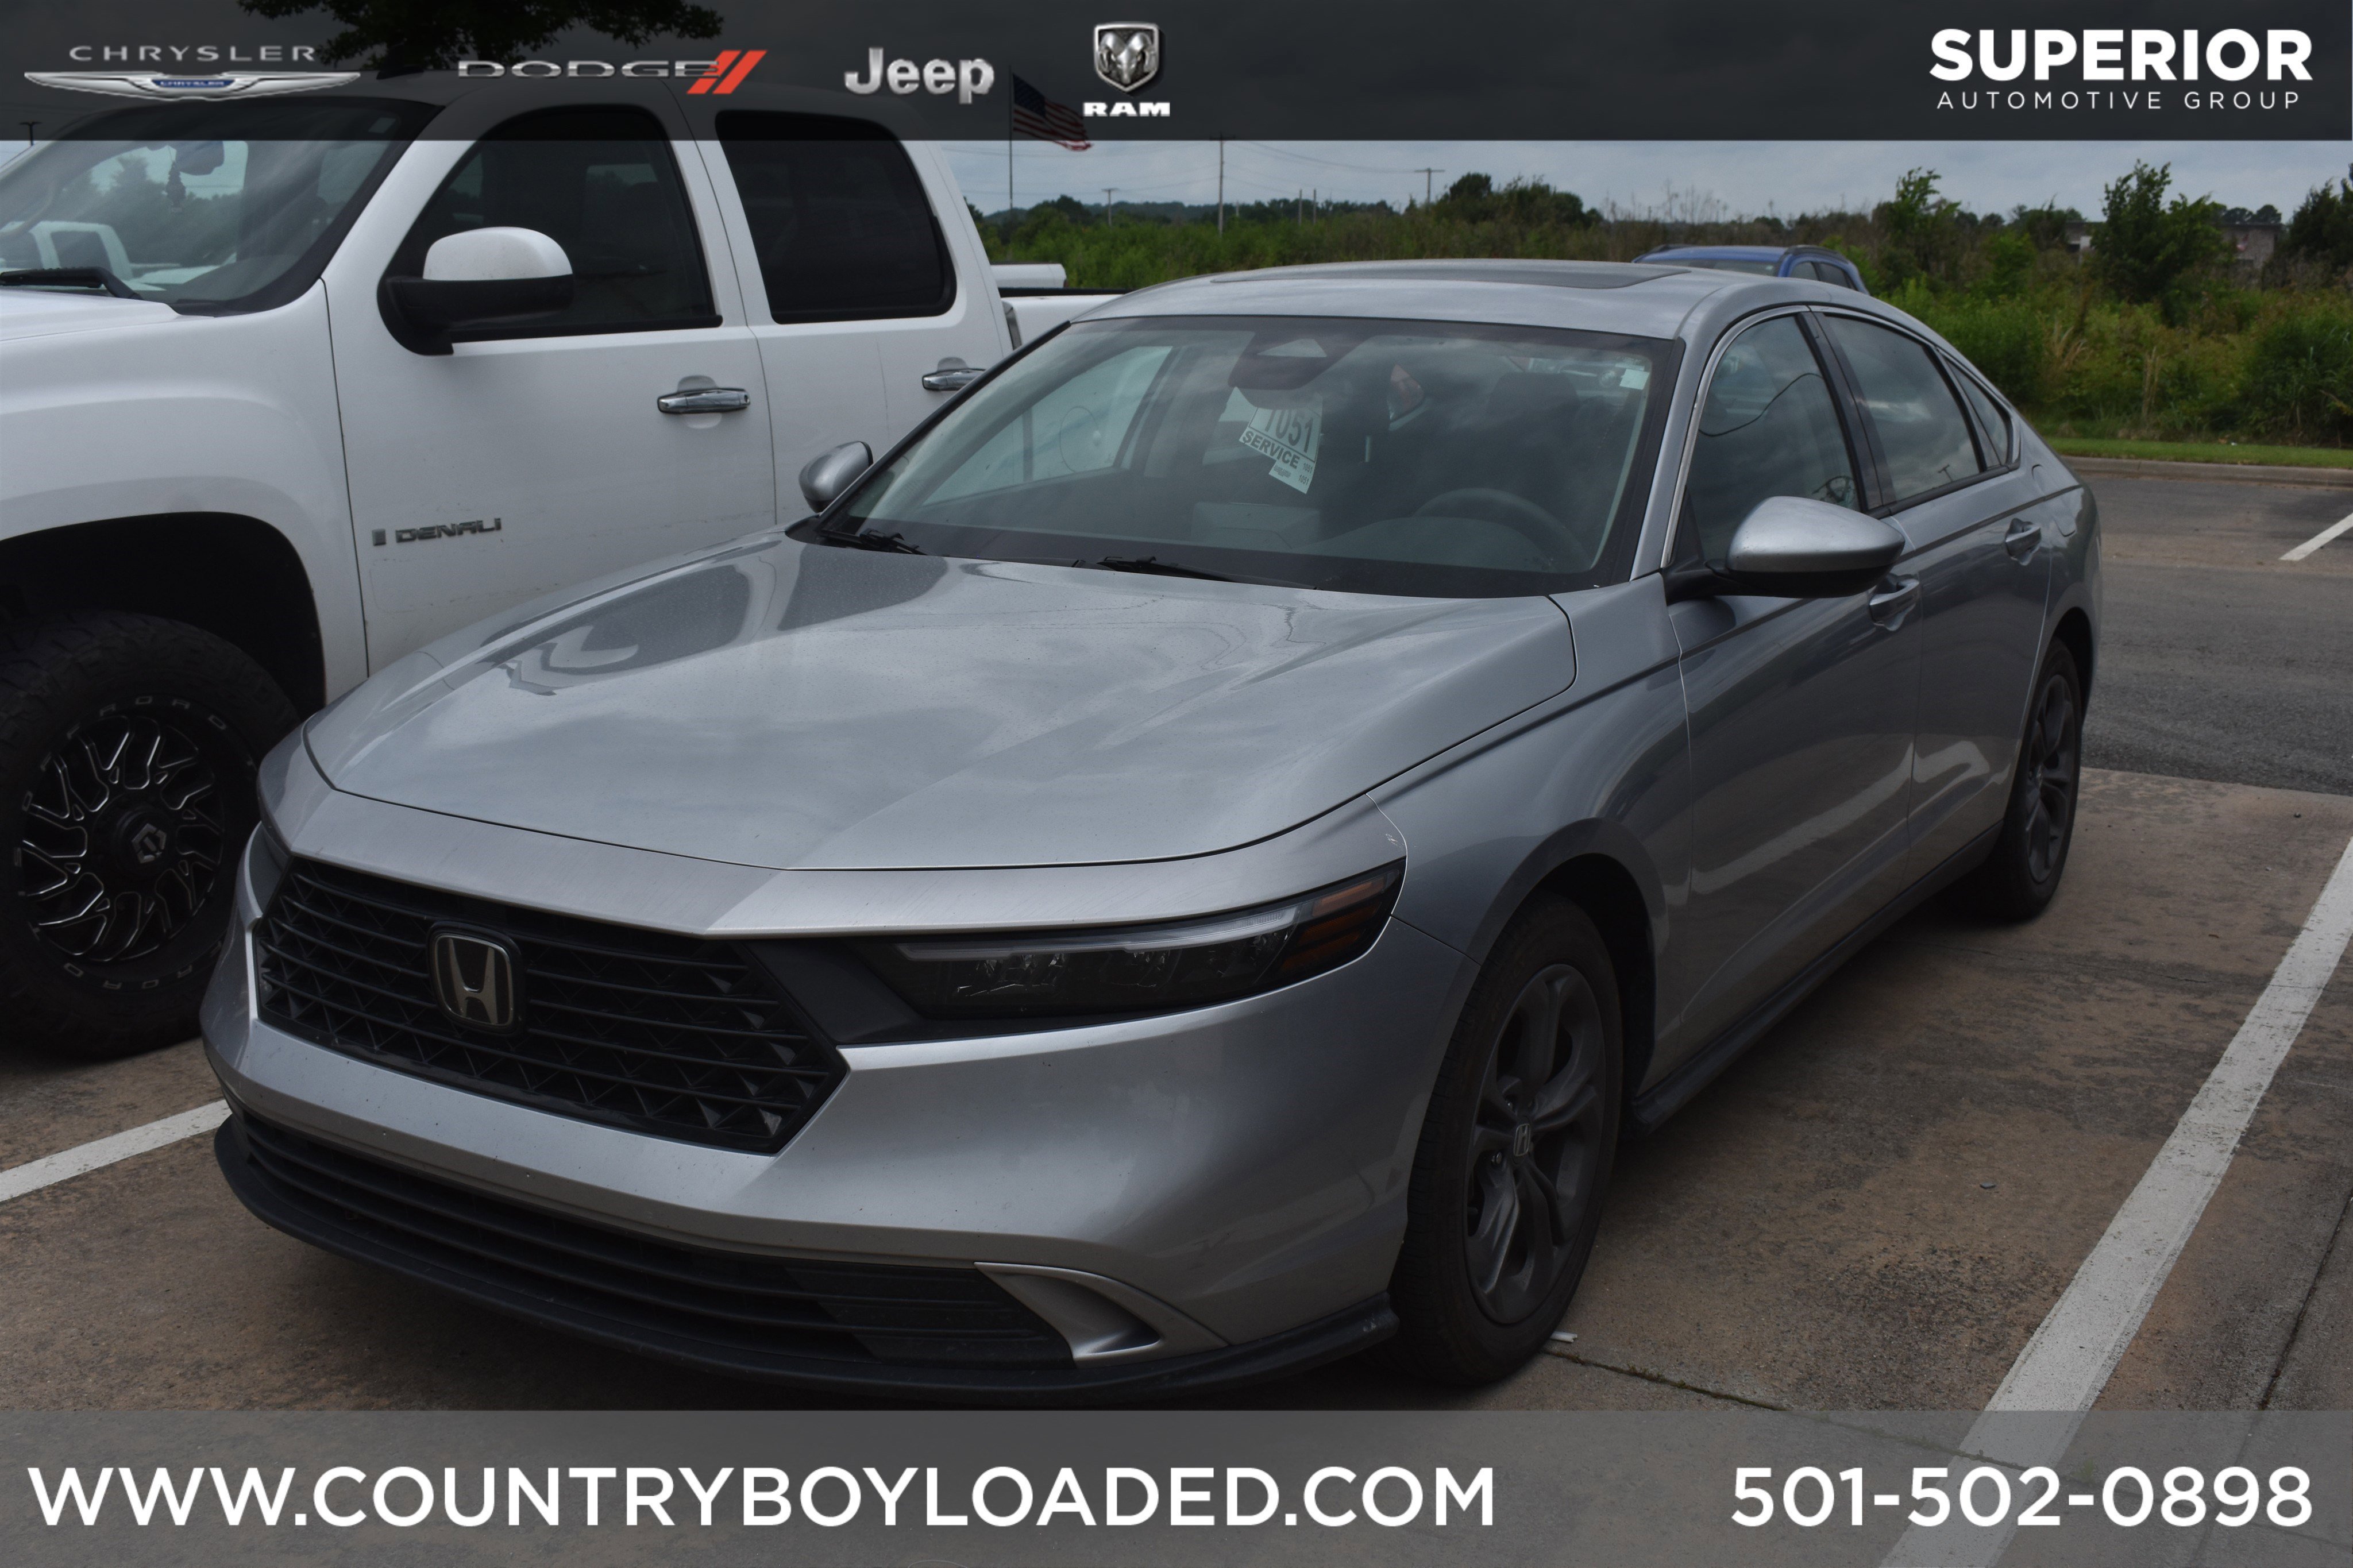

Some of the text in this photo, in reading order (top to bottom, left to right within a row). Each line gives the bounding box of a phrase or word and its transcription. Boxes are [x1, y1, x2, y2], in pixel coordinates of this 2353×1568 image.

[1243, 430, 1301, 469] SERVICE
[1303, 462, 1313, 474] 1051
[1298, 473, 1310, 485] 1051
[395, 517, 502, 543] DENALI
